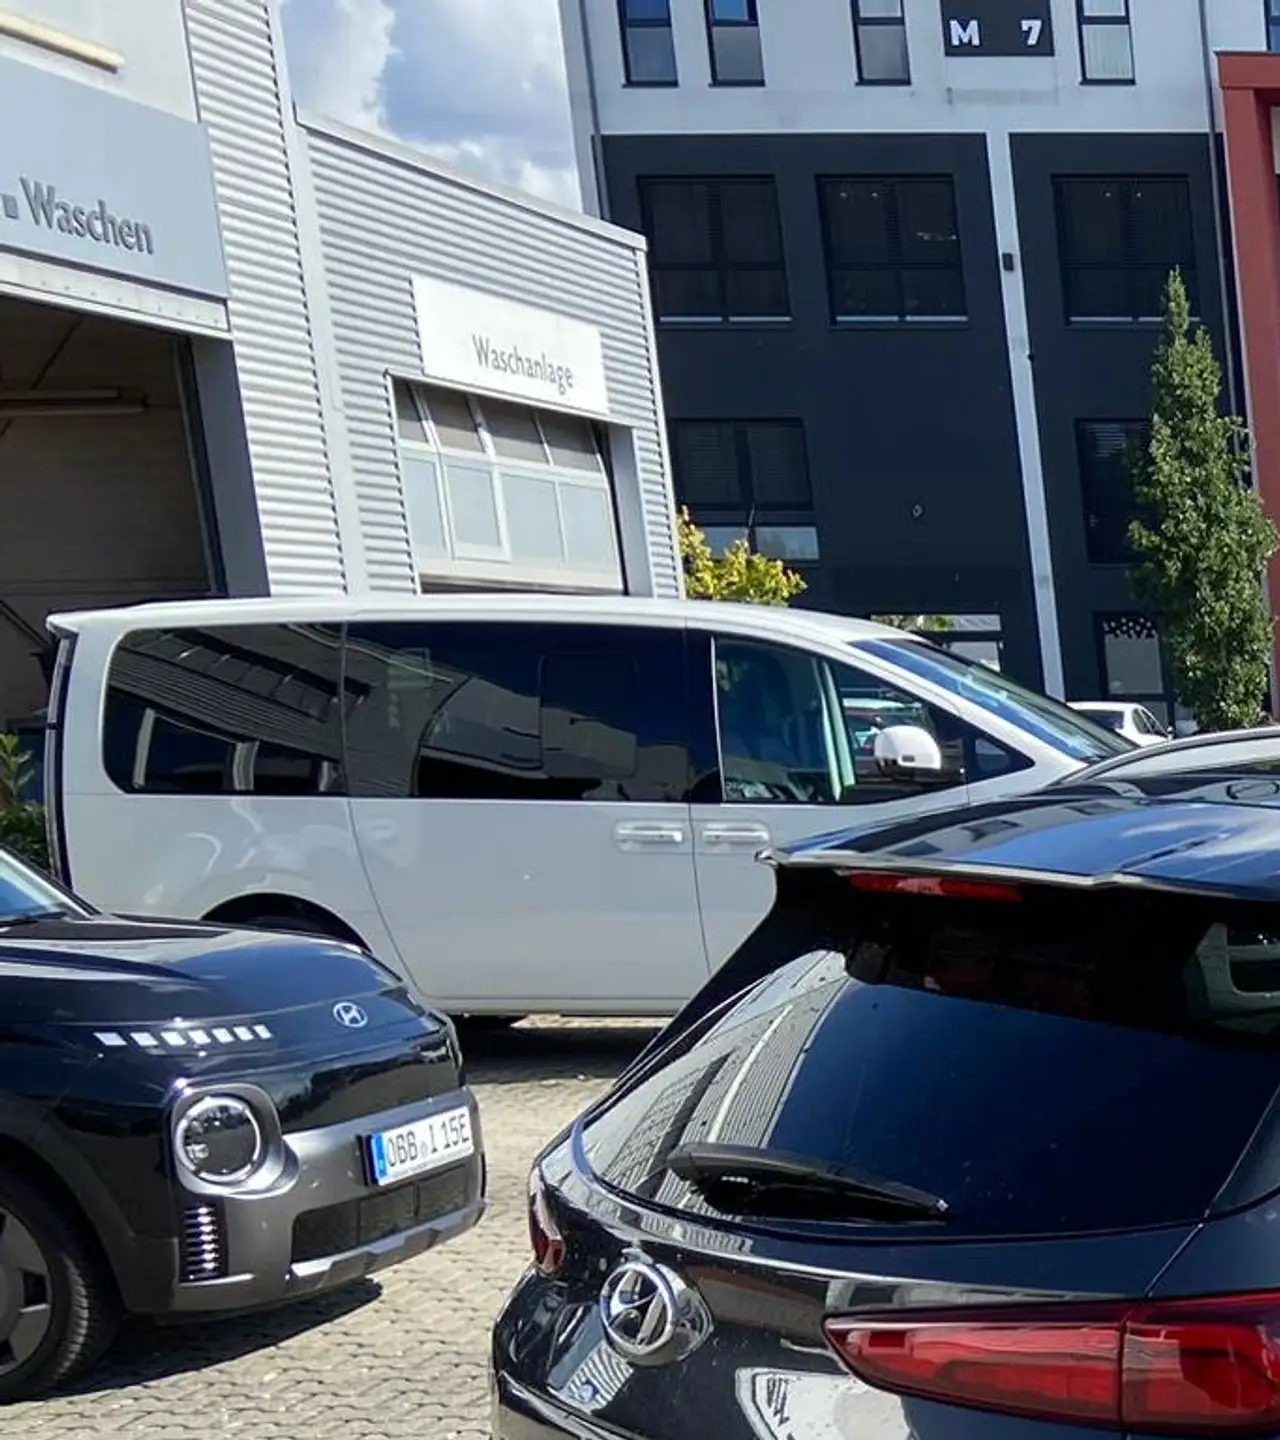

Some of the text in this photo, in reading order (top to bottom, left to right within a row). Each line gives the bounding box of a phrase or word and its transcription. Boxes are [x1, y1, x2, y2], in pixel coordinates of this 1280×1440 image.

[949, 20, 1042, 46] M 7
[19, 176, 154, 255] Waschen
[471, 333, 575, 396] Waschanlage
